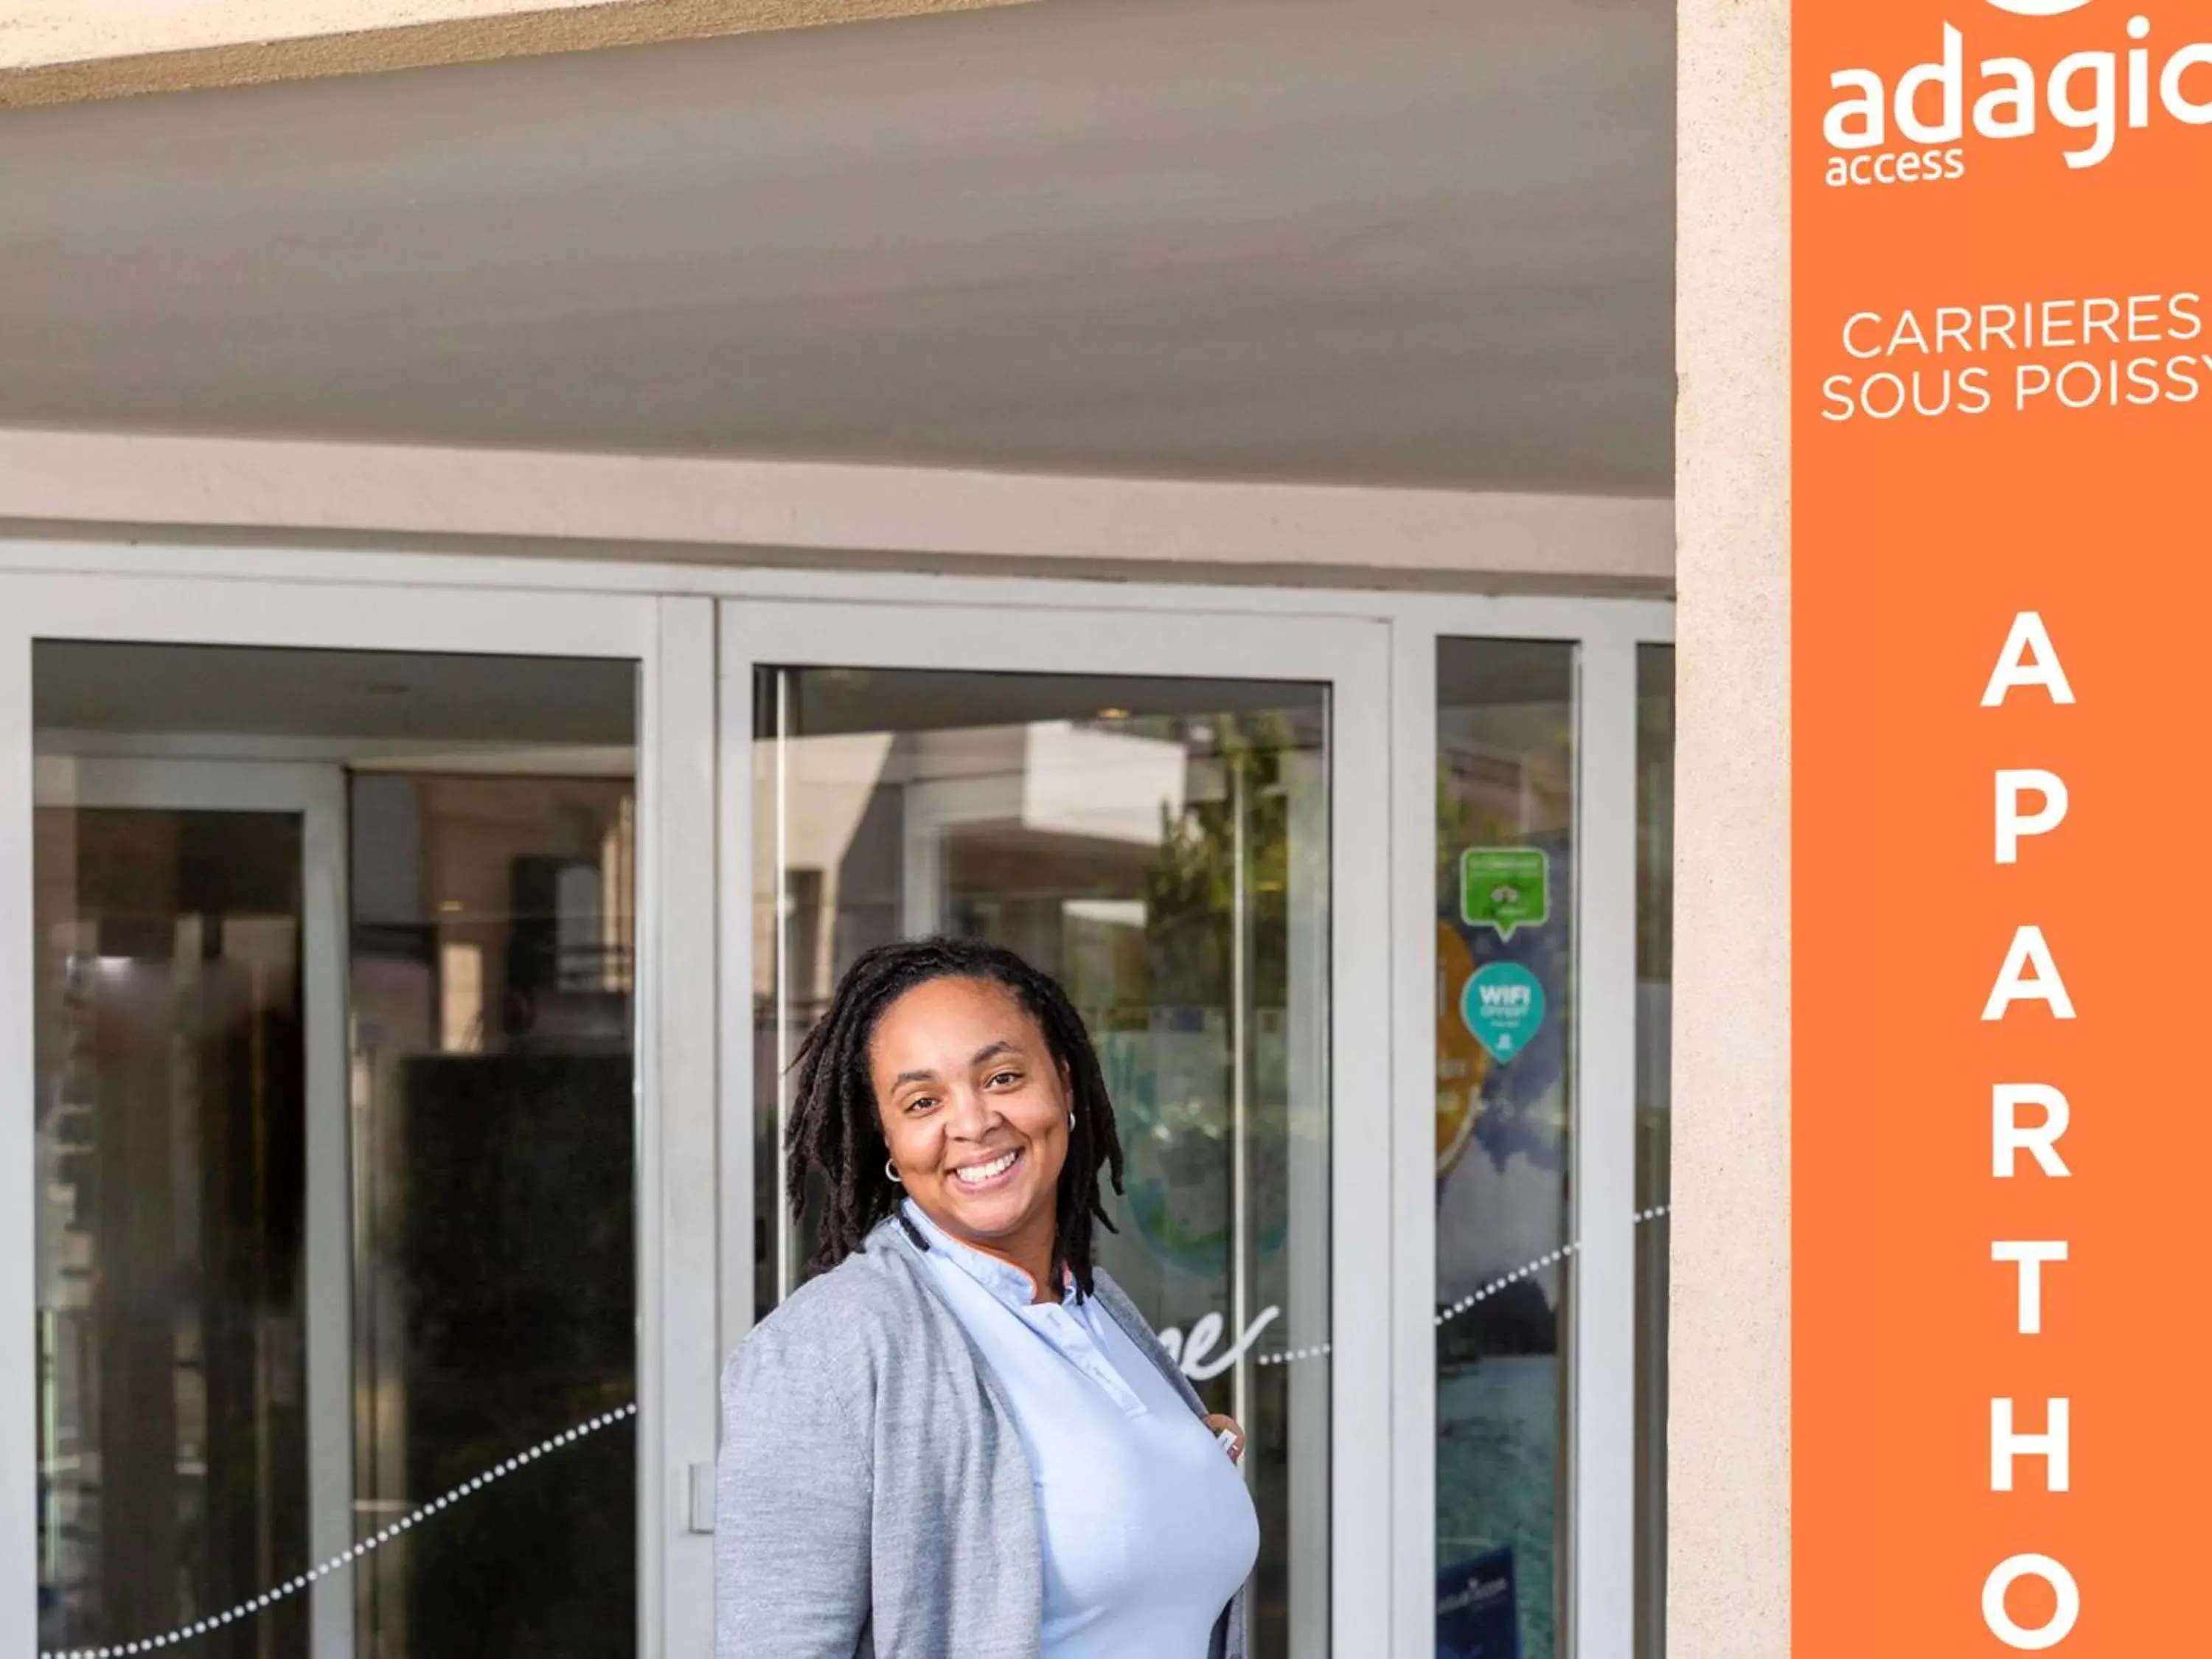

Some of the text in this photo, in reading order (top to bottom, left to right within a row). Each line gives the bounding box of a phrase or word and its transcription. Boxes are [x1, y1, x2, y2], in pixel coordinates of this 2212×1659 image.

[1825, 148, 1964, 187] access
[1843, 293, 2202, 358] CARRIERES
[1822, 355, 2212, 422] SOUS POISS
[1479, 984, 1531, 1006] WIFI
